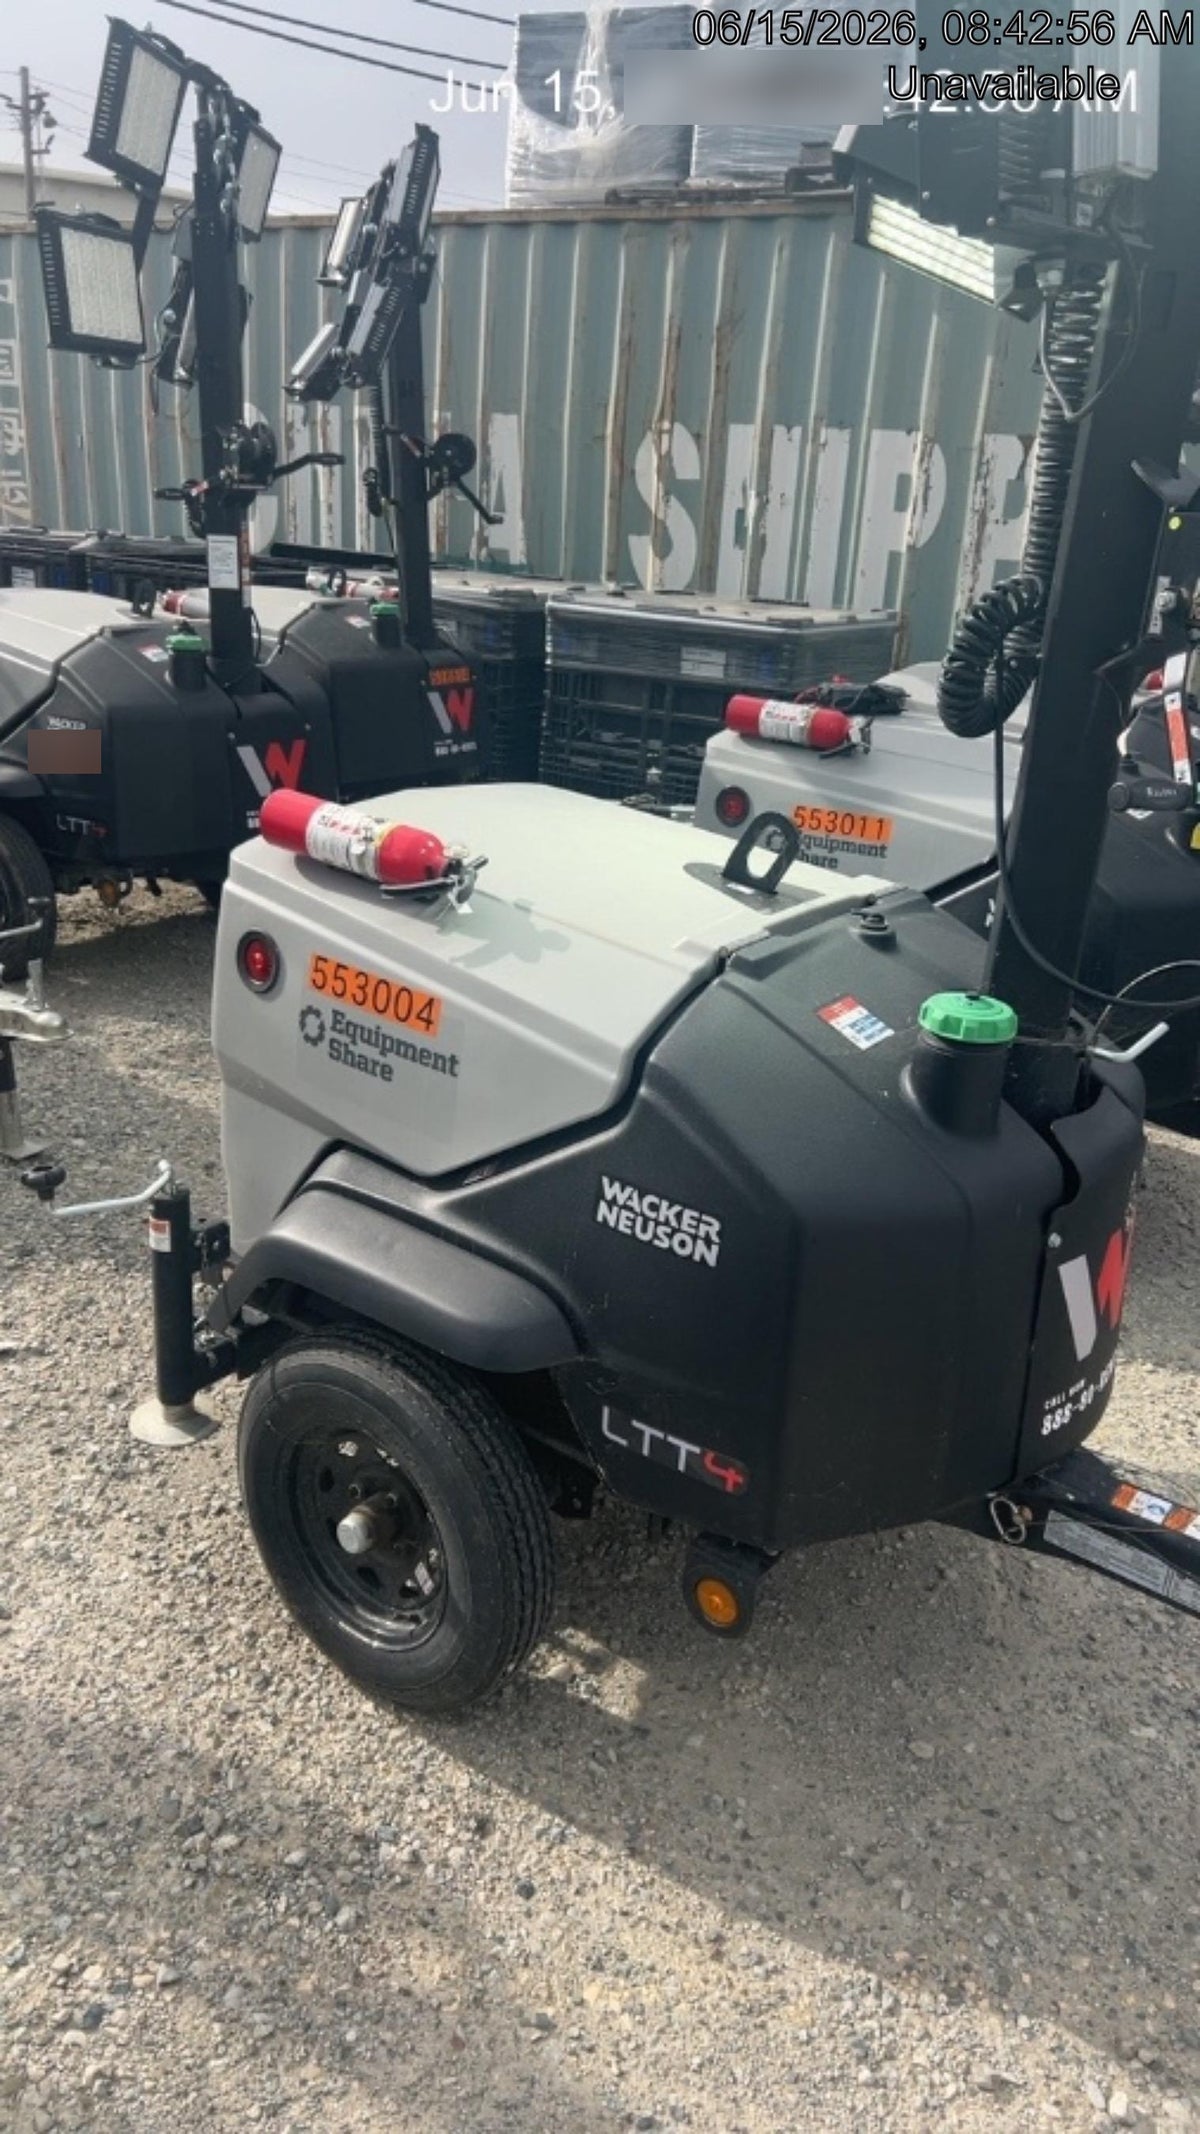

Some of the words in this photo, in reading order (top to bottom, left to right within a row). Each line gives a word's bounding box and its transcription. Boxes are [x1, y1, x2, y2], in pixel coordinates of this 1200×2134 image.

[794, 805, 885, 840] 553011
[799, 834, 889, 859] quipment
[799, 850, 839, 869] hare
[312, 955, 436, 1031] 553004
[328, 1038, 394, 1082] Share
[330, 1009, 460, 1077] Equipment
[597, 1199, 720, 1268] NEUSON
[601, 1175, 721, 1244] WACKER
[602, 1405, 744, 1492] LTT4
